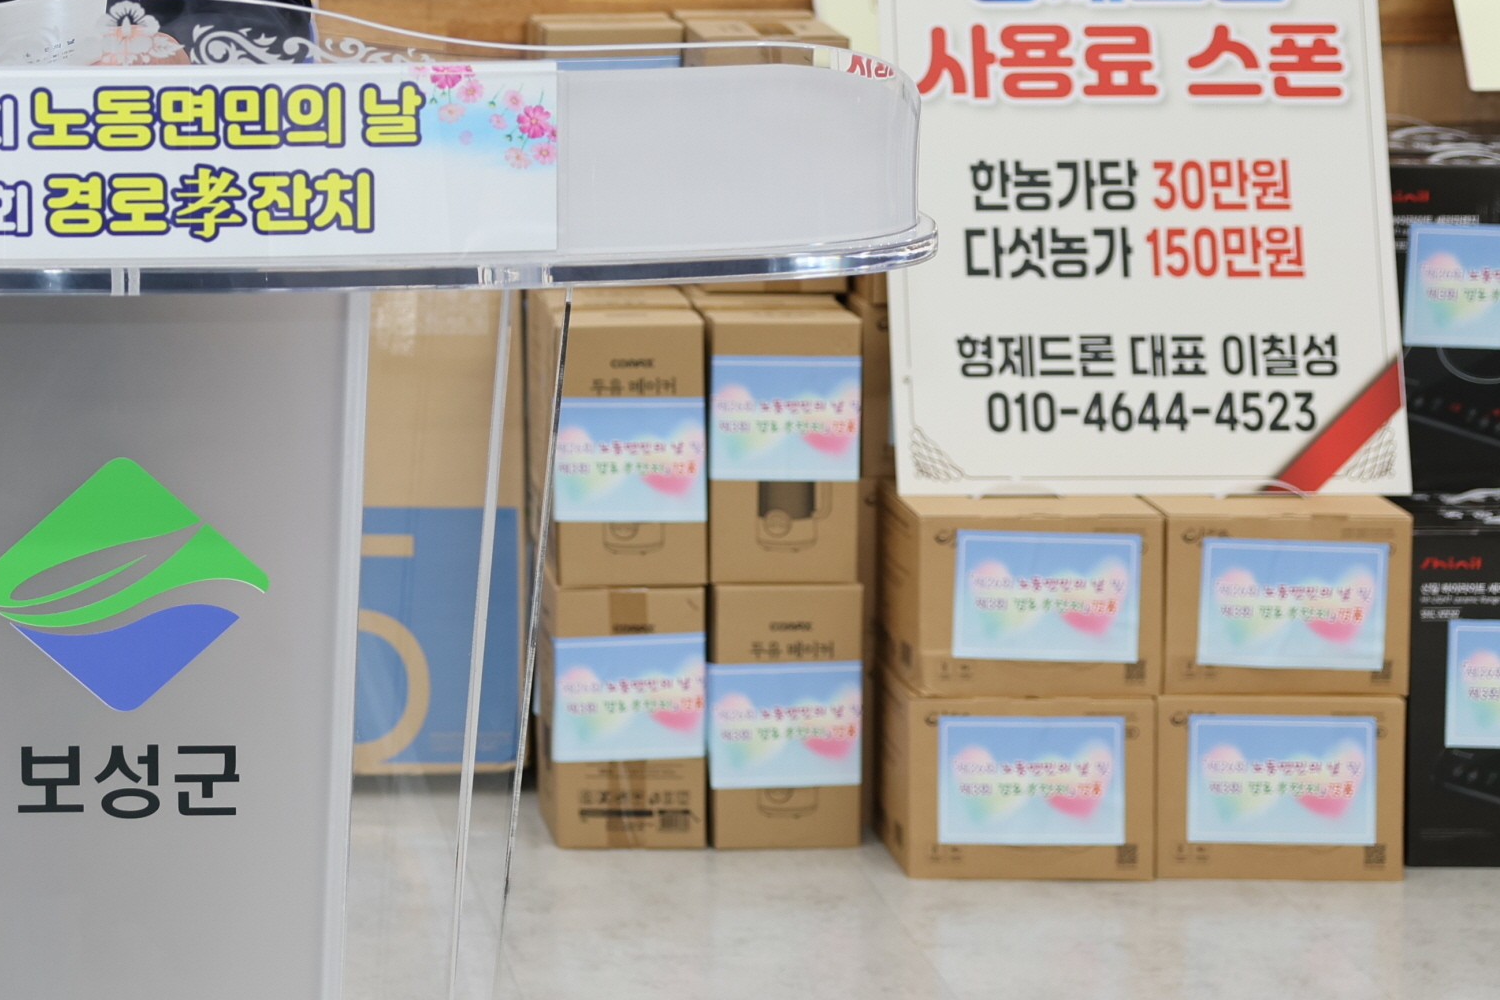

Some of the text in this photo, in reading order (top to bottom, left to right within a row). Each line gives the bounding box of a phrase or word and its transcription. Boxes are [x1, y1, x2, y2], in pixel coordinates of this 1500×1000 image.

[917, 23, 1344, 99] 사용료 스폰
[28, 83, 344, 152] 노동면민의
[361, 81, 425, 147] 날
[970, 158, 1293, 211] 한농가당 30만원
[965, 226, 1306, 279] 다섯농가 150만원
[956, 335, 1339, 378] 형제드론 대표 이칠성
[986, 391, 1318, 433] 010-4644-4523
[17, 743, 240, 819] 보성군
